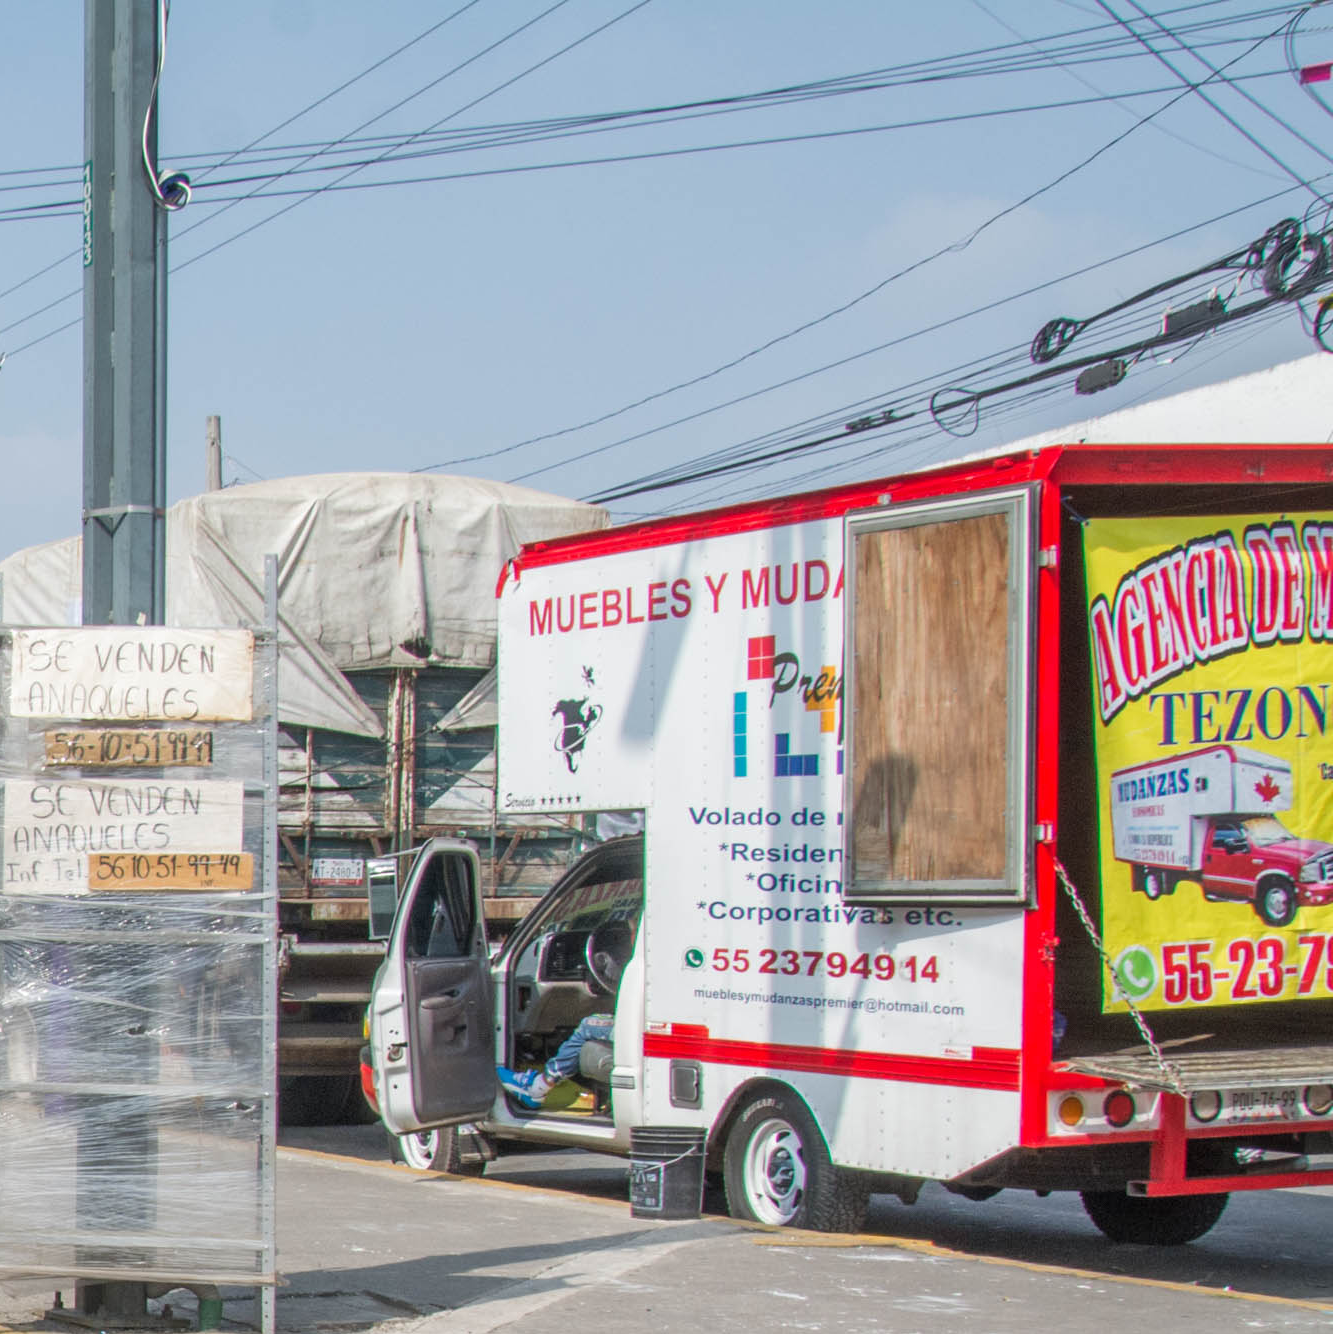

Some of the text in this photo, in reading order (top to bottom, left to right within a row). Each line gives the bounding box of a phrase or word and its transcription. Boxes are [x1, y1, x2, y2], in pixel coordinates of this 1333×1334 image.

[530, 578, 692, 637] MUEBLES
[704, 572, 728, 613] Y
[1091, 529, 1249, 727] AGENCIA
[1243, 520, 1305, 648] DE
[29, 640, 215, 674] SE VENDEN
[27, 681, 200, 720] ANAQUELES
[30, 785, 201, 819] SE VENDEN
[689, 807, 781, 826] Volado
[791, 808, 825, 826] de
[13, 822, 170, 854] ANAQUELES
[904, 906, 963, 926] etc.
[712, 948, 750, 972] 55
[1162, 934, 1333, 1003] 55-23-7
[694, 987, 965, 1016] mueblesymudanzaspremier@hotmail.com
